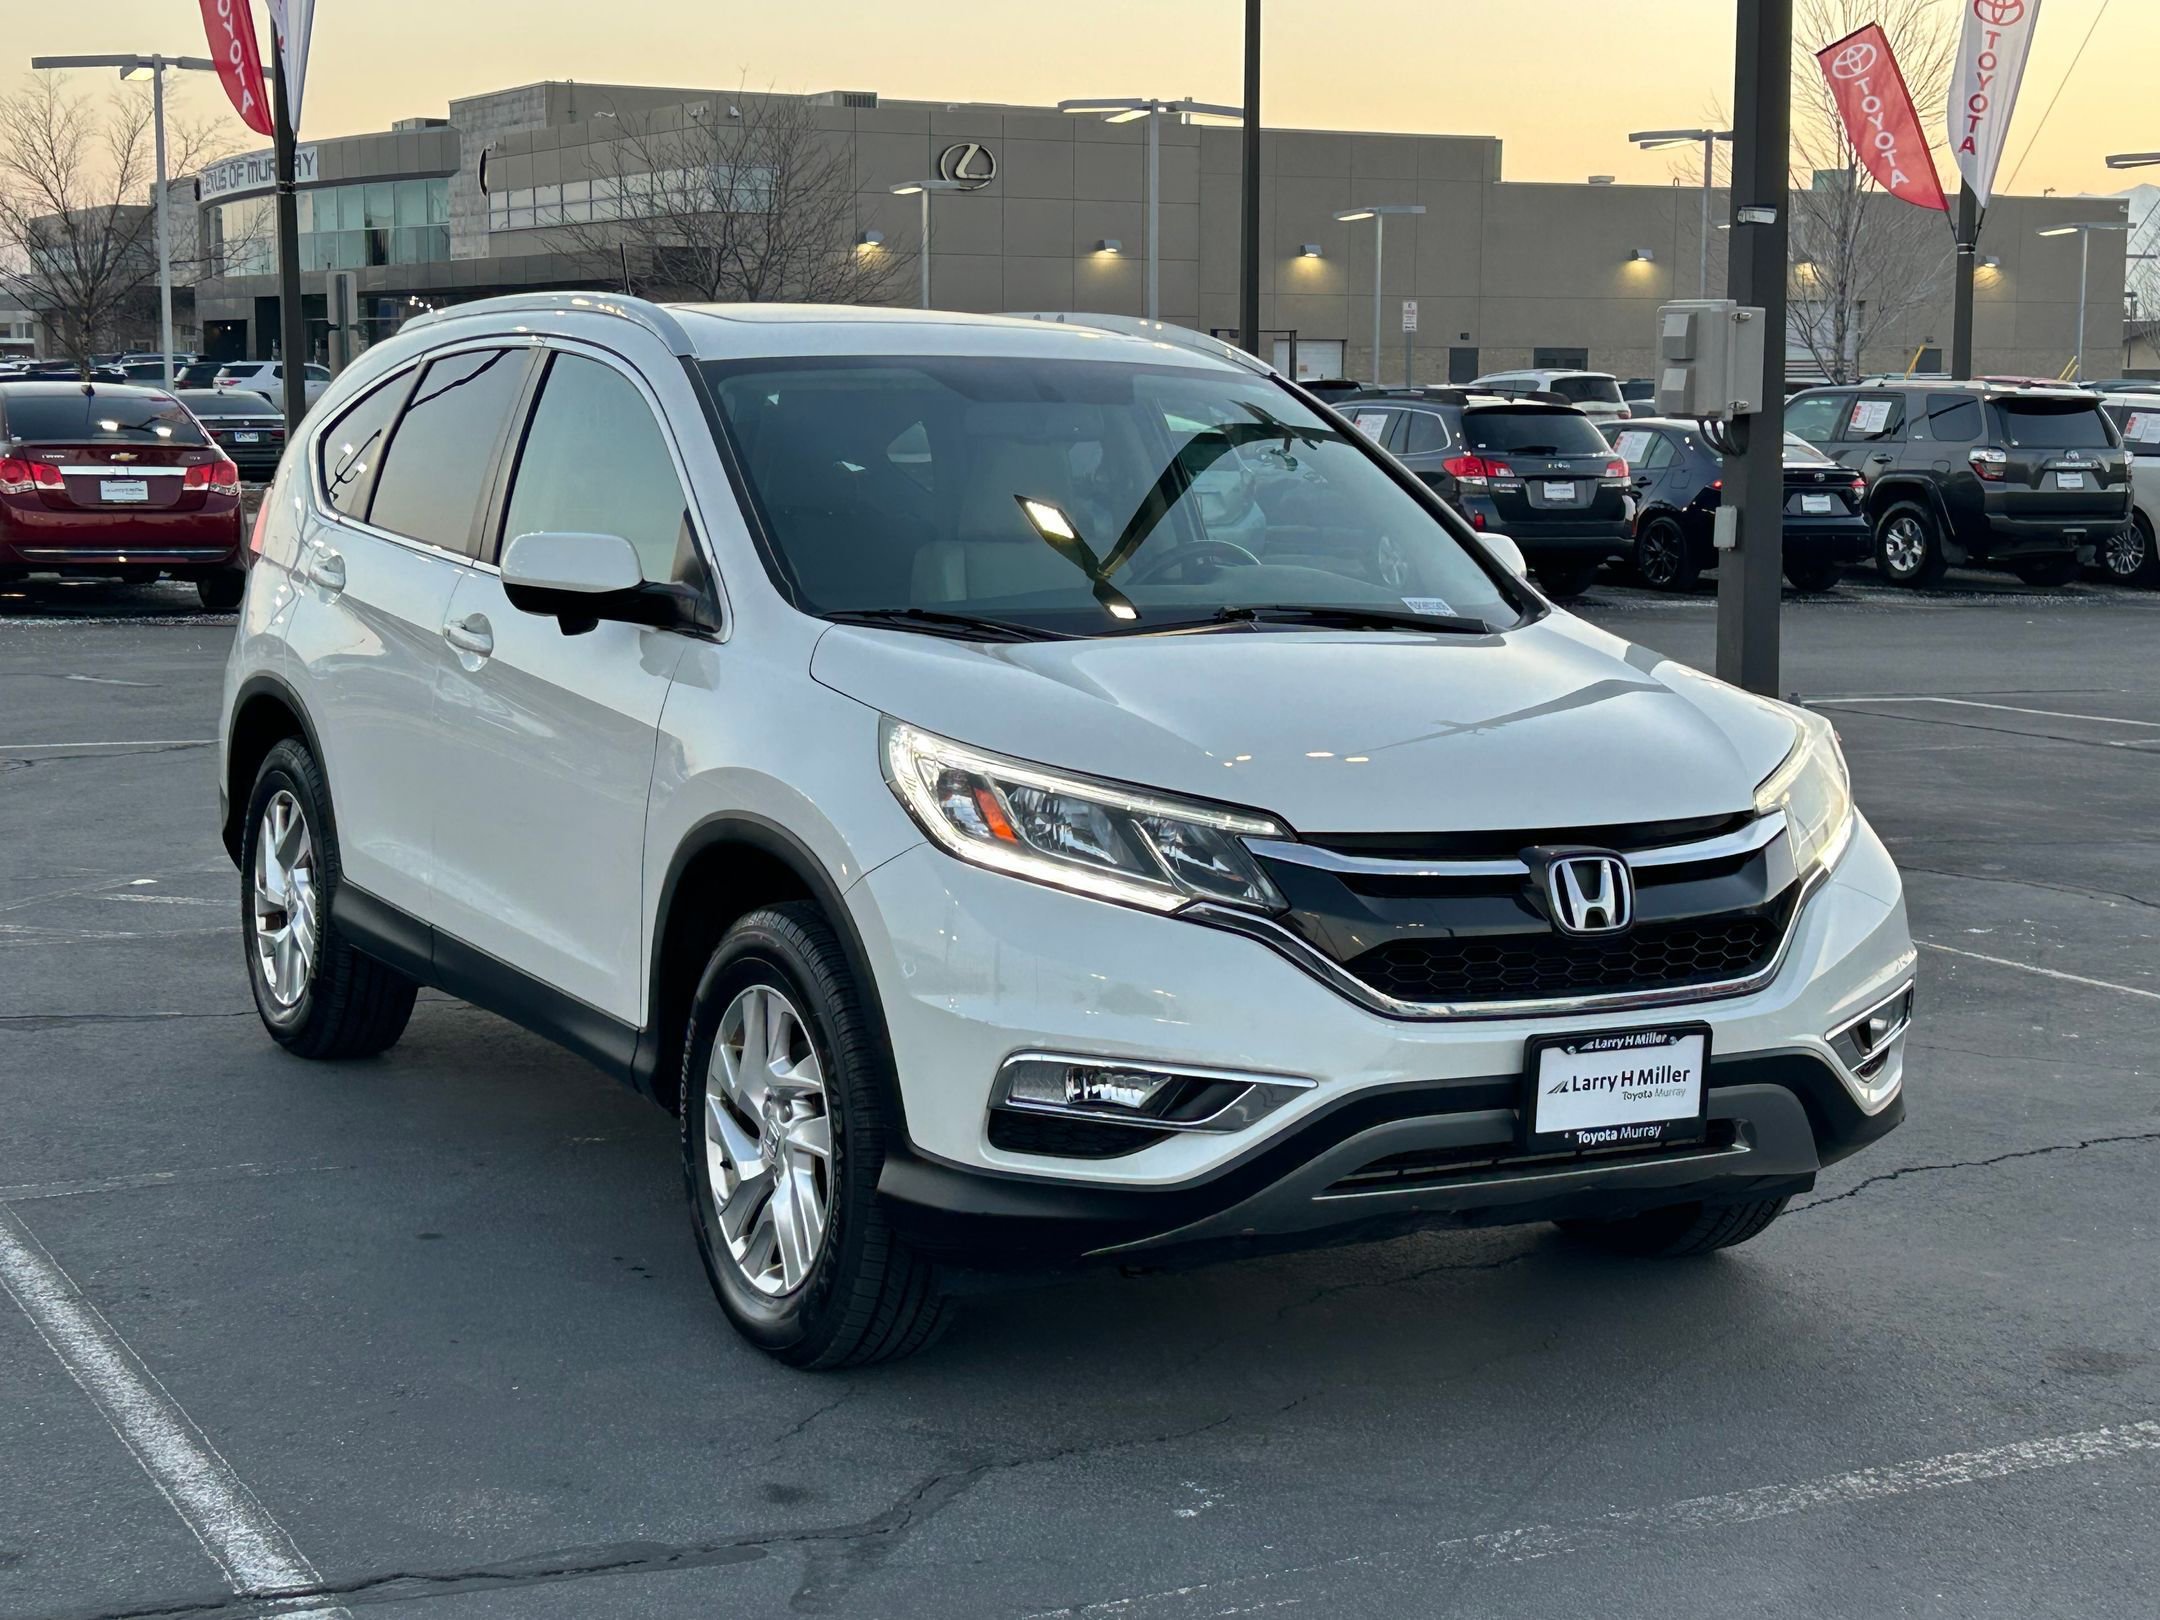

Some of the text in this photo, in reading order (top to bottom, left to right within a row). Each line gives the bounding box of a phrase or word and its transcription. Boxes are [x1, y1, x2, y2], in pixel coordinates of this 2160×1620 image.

[217, 0, 255, 114] OYOTA
[1958, 30, 2001, 155] TOYOTA
[1854, 77, 1910, 189] TOYOTA
[229, 163, 244, 189] OF
[247, 152, 315, 184] MURAY
[1594, 1032, 1667, 1049] Larry H Miller
[1573, 1065, 1690, 1092] Larry H Miller
[1622, 1088, 1686, 1101] Toyota Murray
[1576, 1125, 1661, 1145] Toyota Murray
